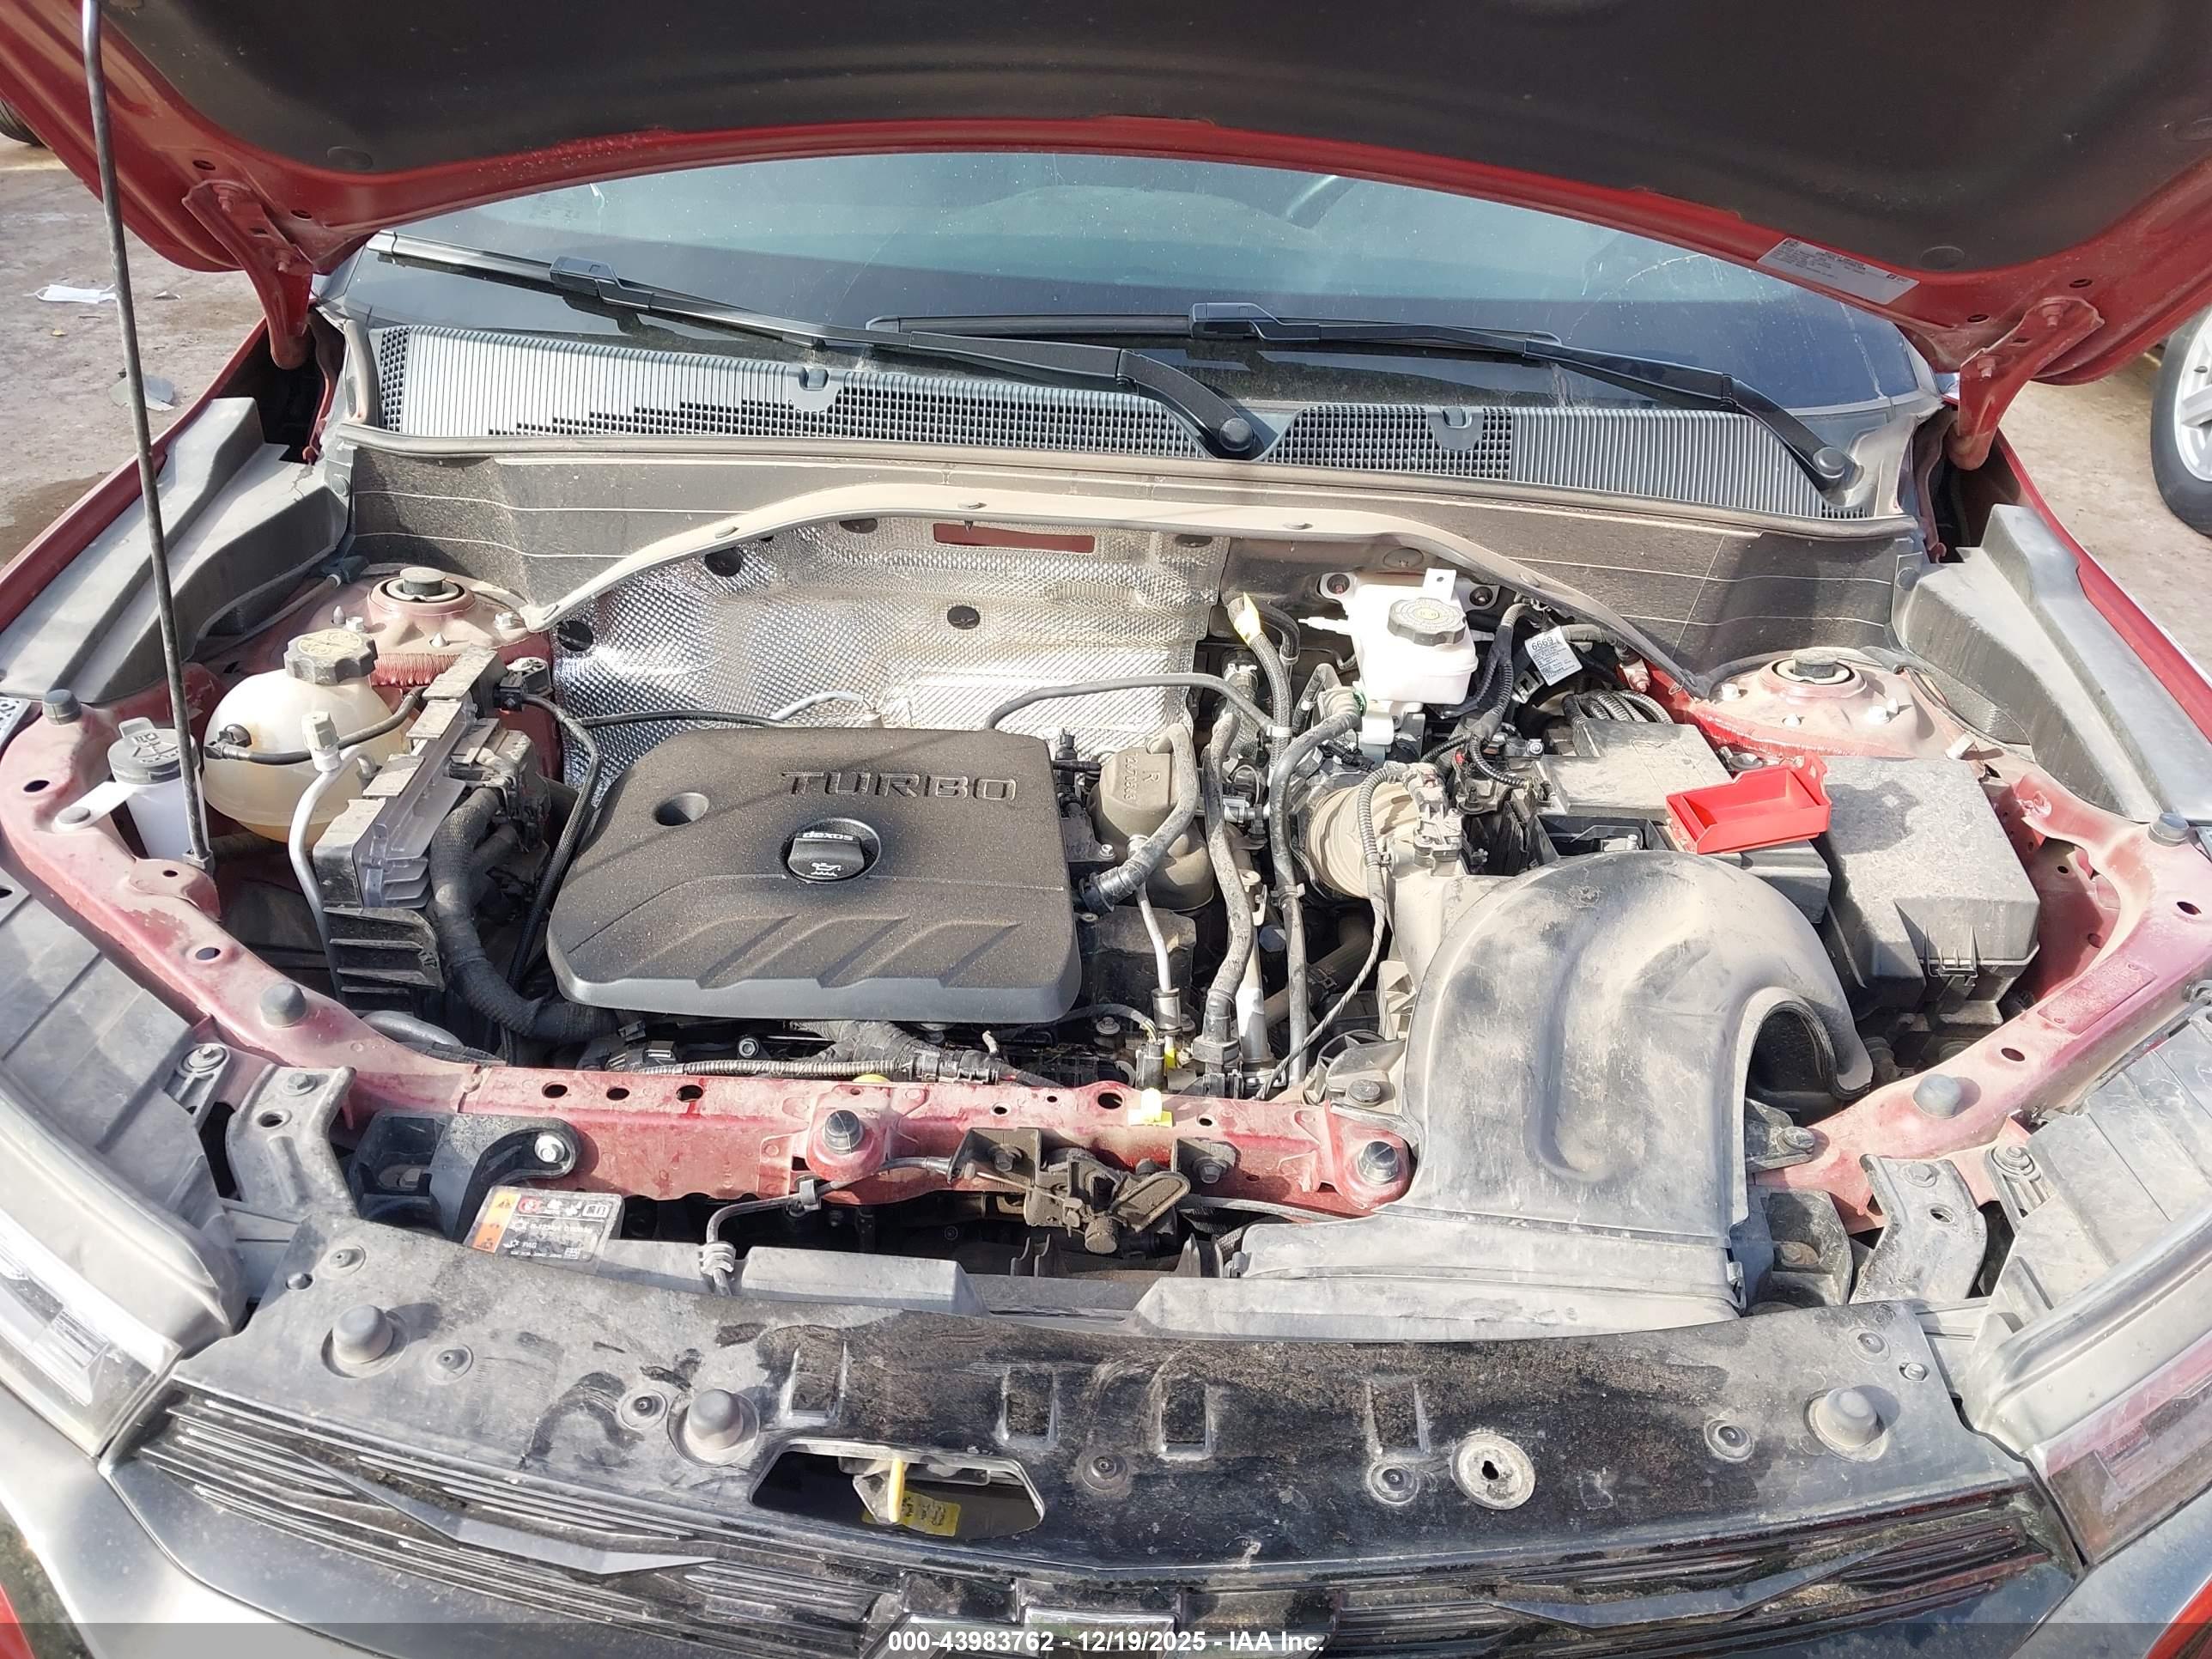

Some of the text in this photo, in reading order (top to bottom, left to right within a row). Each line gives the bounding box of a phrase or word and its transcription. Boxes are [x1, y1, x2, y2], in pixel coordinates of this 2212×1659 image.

[1531, 636, 1553, 650] 6669
[781, 770, 1017, 801] TURBO
[802, 830, 854, 842] dexos
